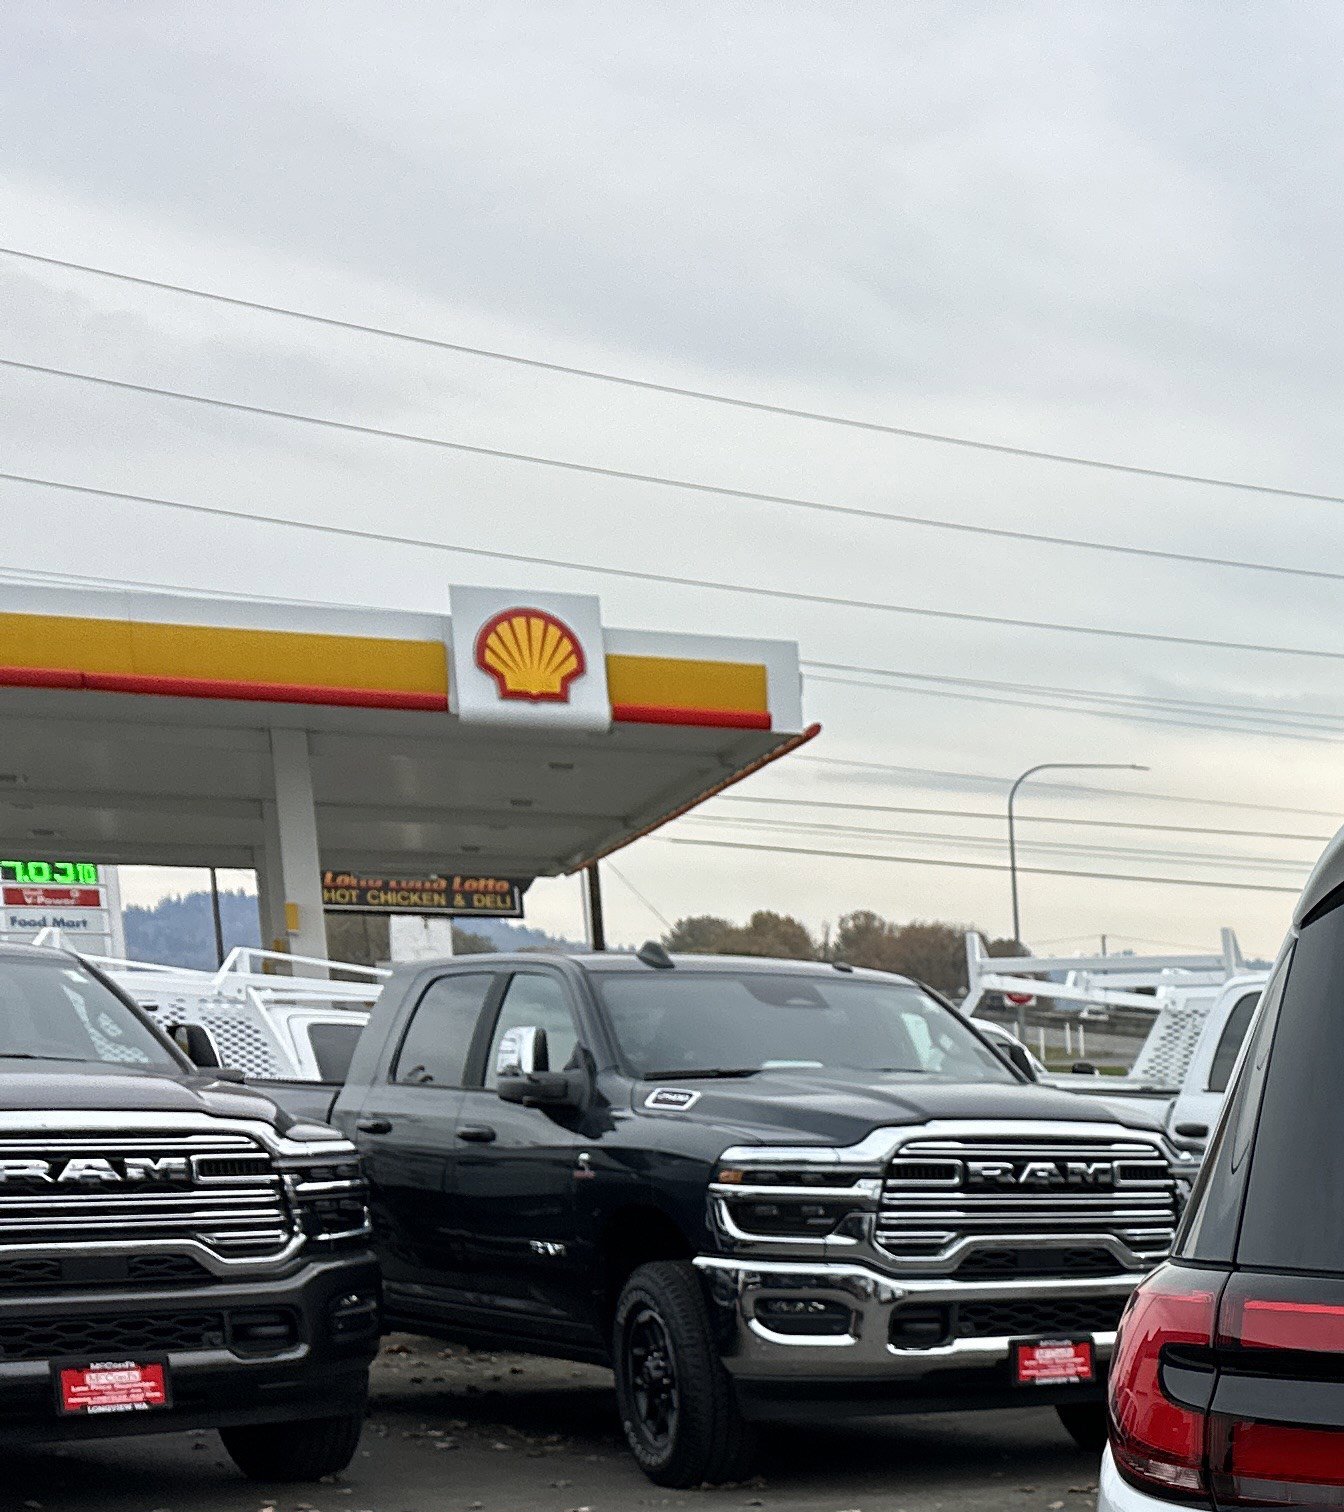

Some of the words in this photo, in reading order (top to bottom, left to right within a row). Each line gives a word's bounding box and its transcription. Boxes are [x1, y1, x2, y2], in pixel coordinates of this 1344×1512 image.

[323, 888, 358, 904] HOT
[367, 890, 446, 906] CHICKEN
[453, 893, 465, 907] &
[473, 893, 511, 909] DELI
[10, 915, 46, 927] Food
[52, 917, 87, 928] Mart
[0, 1158, 188, 1183] RAM
[966, 1161, 1112, 1184] RAM
